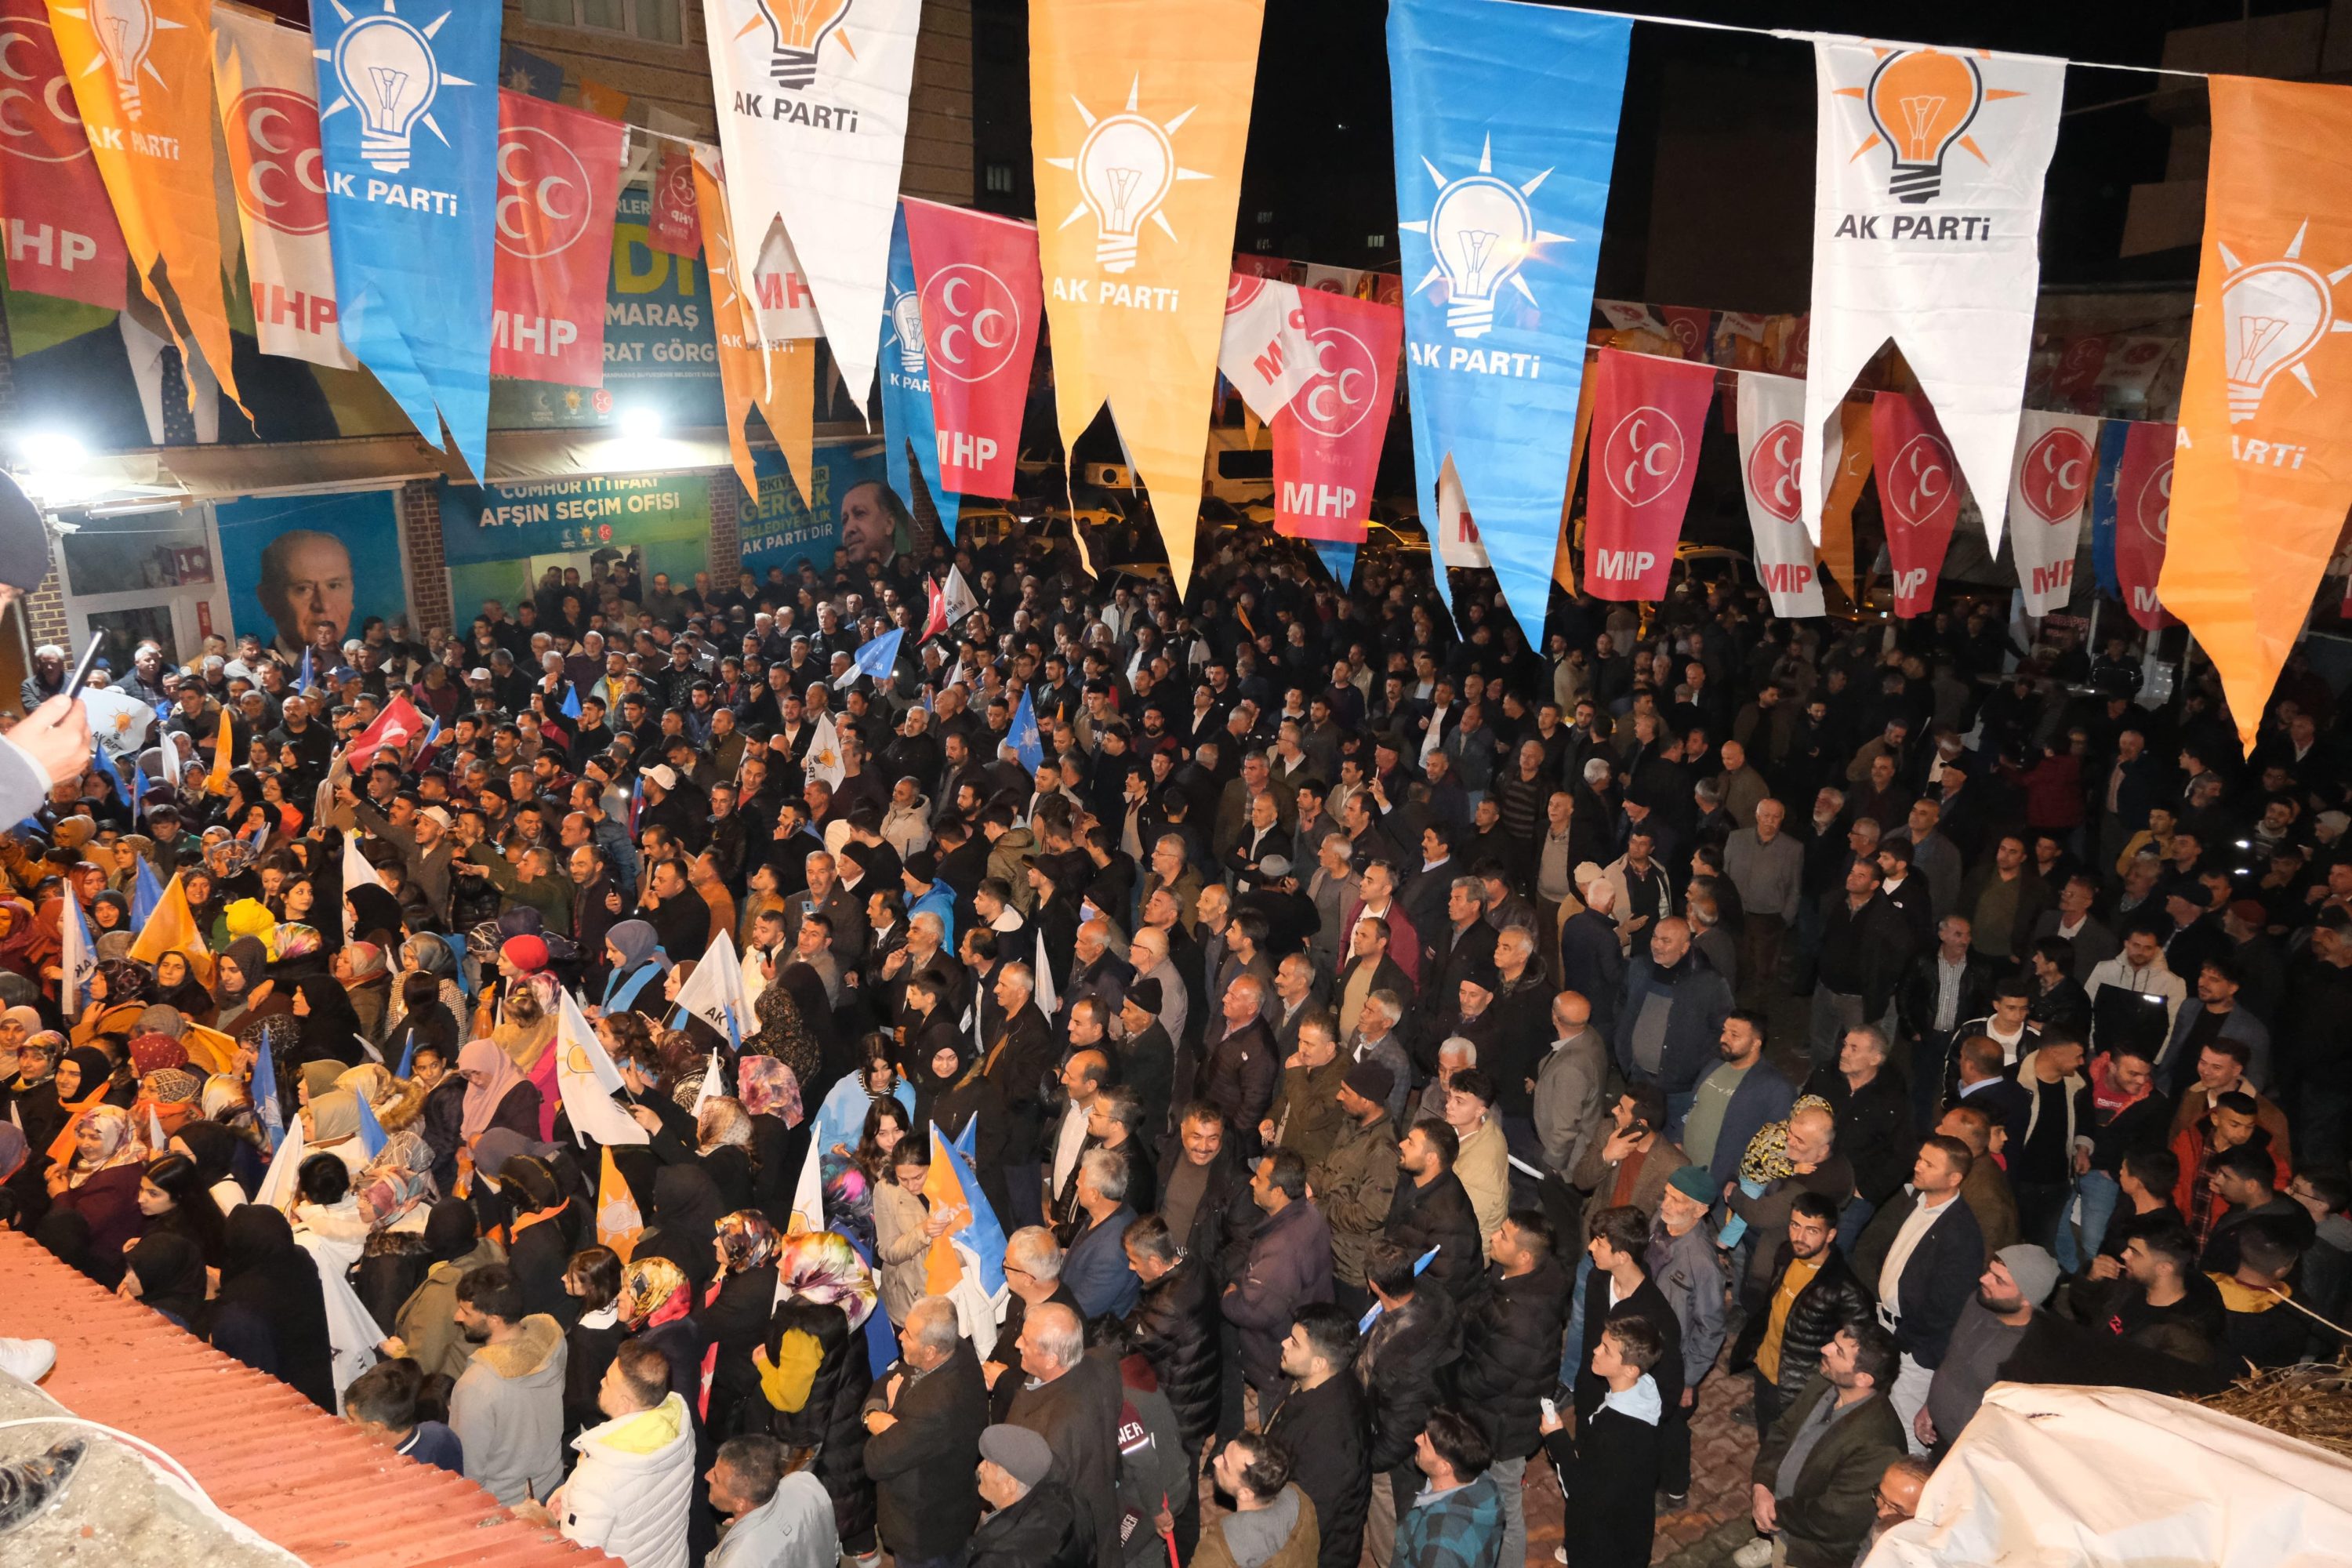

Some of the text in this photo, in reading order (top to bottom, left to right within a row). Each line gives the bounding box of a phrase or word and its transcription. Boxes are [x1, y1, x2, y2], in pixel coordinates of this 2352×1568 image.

[734, 91, 763, 118] AK
[88, 124, 124, 151] AK
[1835, 215, 1881, 240] AK
[1, 218, 97, 271] HP
[1053, 277, 1087, 302] AK
[722, 334, 742, 348] AK
[1410, 343, 1439, 368] AK
[1283, 481, 1356, 518] MHP
[742, 539, 762, 555] AK
[1596, 549, 1654, 581] MHP
[704, 1007, 727, 1025] AK
